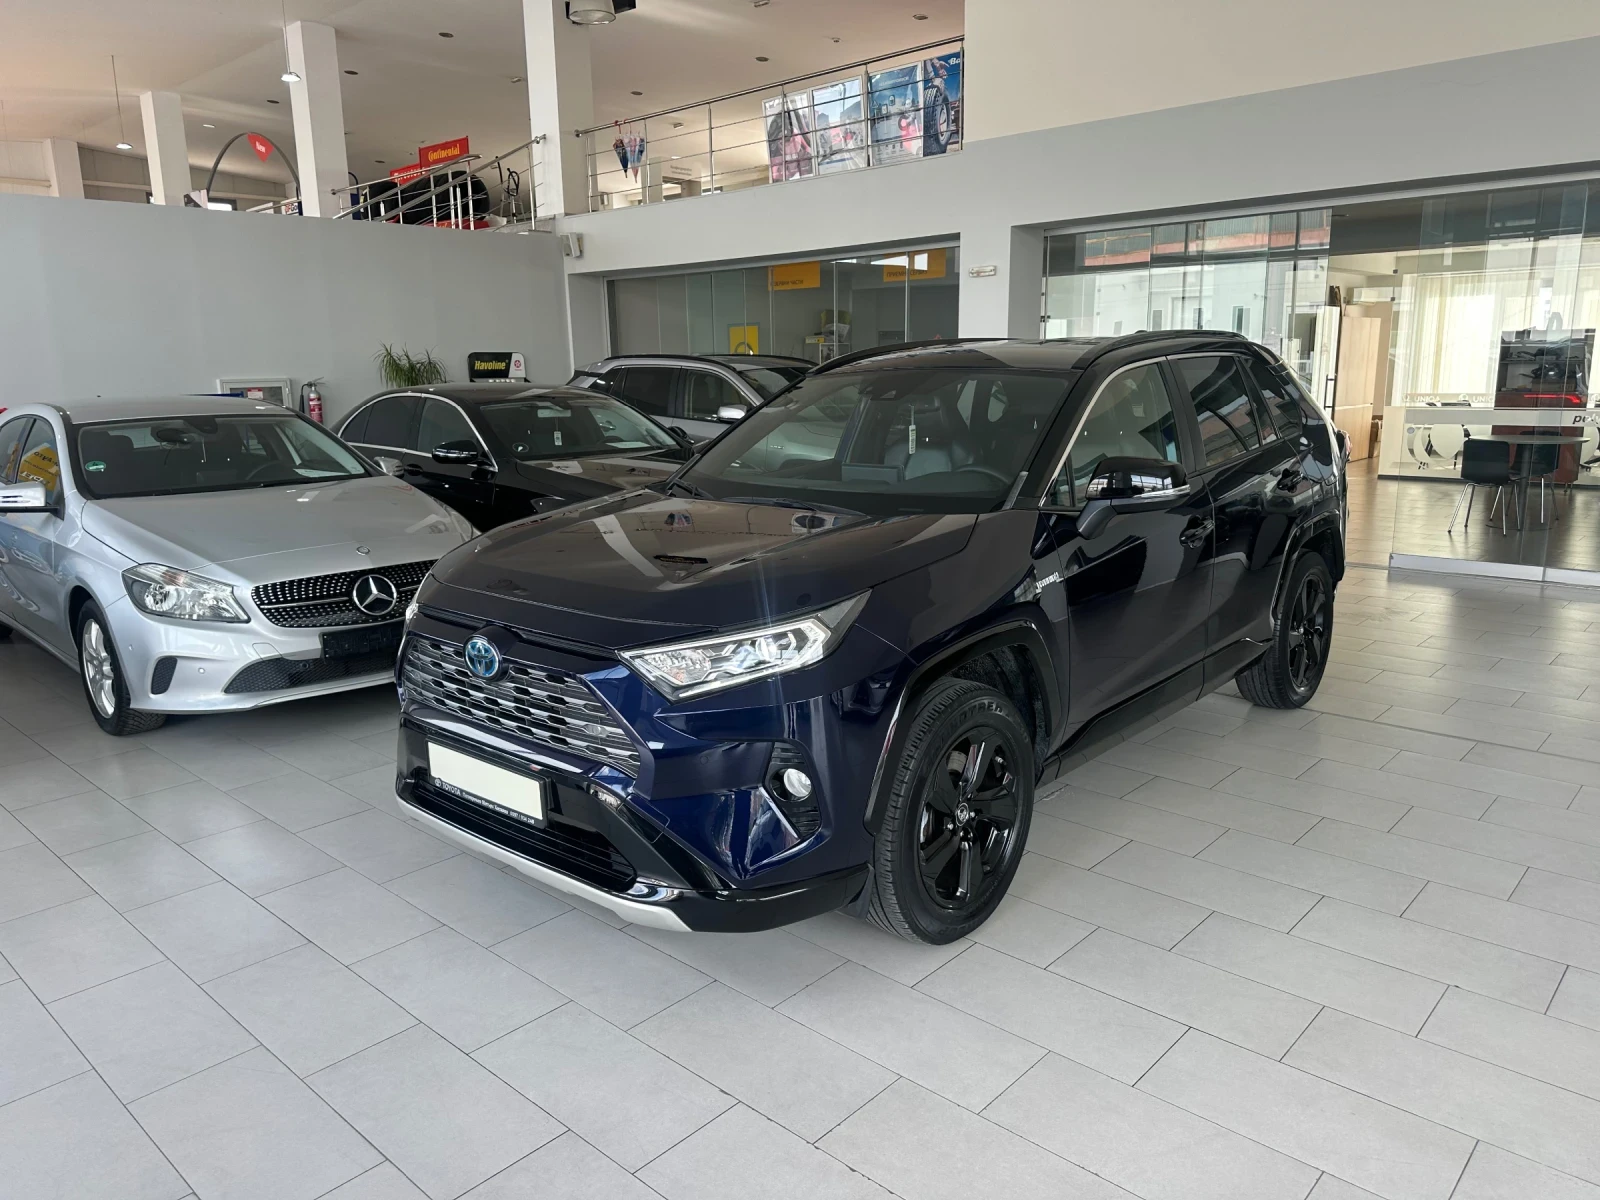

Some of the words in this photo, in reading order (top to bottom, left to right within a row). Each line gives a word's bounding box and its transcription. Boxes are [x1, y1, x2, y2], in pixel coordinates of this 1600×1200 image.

[428, 143, 460, 162] Continental
[473, 359, 506, 370] Havoline
[442, 781, 461, 796] TOYOTA
